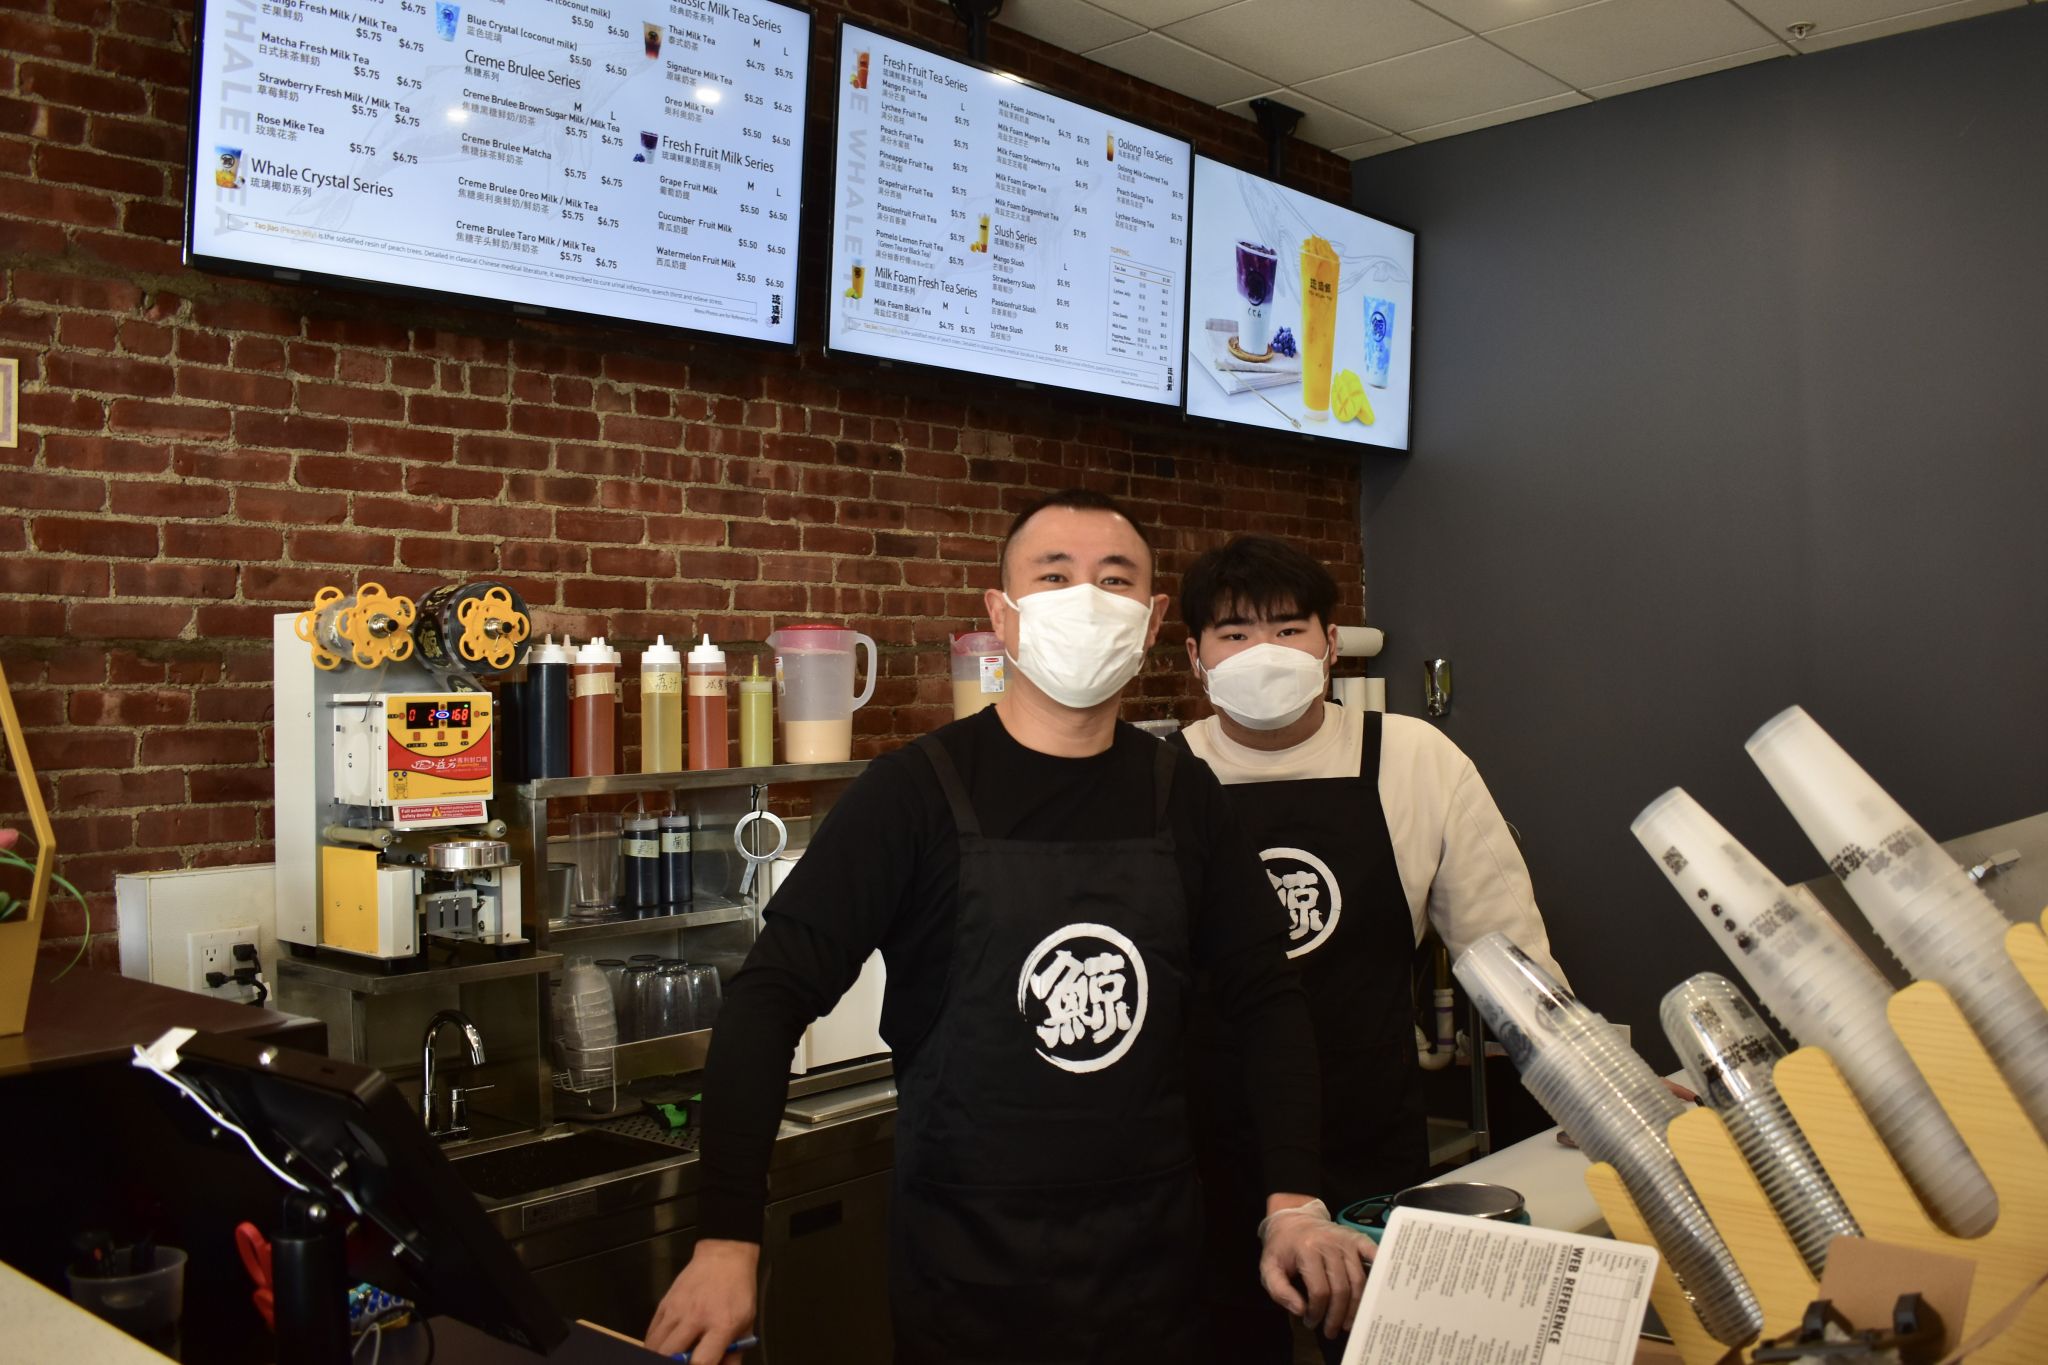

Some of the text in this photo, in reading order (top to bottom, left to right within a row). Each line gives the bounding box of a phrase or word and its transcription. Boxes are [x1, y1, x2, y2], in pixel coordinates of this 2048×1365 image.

[300, 2, 397, 33] Fresh Milk Milk Tea
[467, 14, 487, 27] Blue
[489, 20, 518, 37] Crystal
[708, 3, 782, 34] Milk Tea Series
[356, 28, 424, 52] $5.75 $6.75
[668, 25, 715, 45] Thai Milk Tea
[262, 32, 369, 65] Matcha Fresh Milk Tea
[753, 38, 788, 56] M L
[465, 50, 581, 90] Creme Brulee Series
[569, 54, 627, 77] $5.50 $6.50
[666, 60, 732, 85] Signature Milk Tea
[746, 59, 794, 79] $4.75 $5.75
[883, 55, 968, 92] Fresh Fruit Tea Series
[354, 66, 422, 90] $5.75 $6.75
[259, 72, 410, 112] Strawberry Fresh Milk Milk Tea
[883, 80, 927, 99] Mango Fruit Tea
[463, 88, 620, 132] Creme Brulee Brown Sugar Milk Milk Tea
[574, 102, 615, 120] M L
[665, 96, 714, 116] Oreo Milk Tea
[744, 93, 792, 113] $5.25 $6.25
[882, 101, 927, 122] Lychee Fruit Tea
[257, 113, 324, 134] Rose Mike Tea
[352, 104, 420, 127] $5.75 $6.75
[955, 116, 970, 126] $5.75
[462, 133, 551, 160] Creme Brulee Matcha
[565, 126, 623, 147] $5.75 $6.75
[743, 128, 790, 146] $5.50 $6.50
[350, 142, 418, 164] $5.75 $6.75
[663, 135, 774, 172] Fresh Fruit Milk Series
[1118, 138, 1173, 165] Oolong Tea Series
[252, 158, 394, 198] Whale Crystal Series
[564, 168, 622, 187] $5.75 $6.75
[659, 176, 718, 195] Grape Fruit Milk
[458, 176, 598, 212] Creme Brulee Oreo Milk Milk Tea
[748, 182, 781, 197] M L
[562, 209, 619, 228] $5.75 $6.75
[658, 211, 732, 233] Cucumber Fruit Milk
[740, 204, 787, 221] $5.50 $6.50
[456, 220, 595, 253] Creme Brulee Taro Milk Milk Tea
[995, 225, 1037, 245] Slush Series
[657, 246, 736, 269] Watermelon Fruit Milk
[739, 238, 785, 255] $5.50 $6.50
[737, 272, 784, 289] $5.50 $6.50
[875, 267, 978, 298] Milk Foam Fresh Tea Series
[1548, 1248, 1585, 1345] WEB REFERENCE
